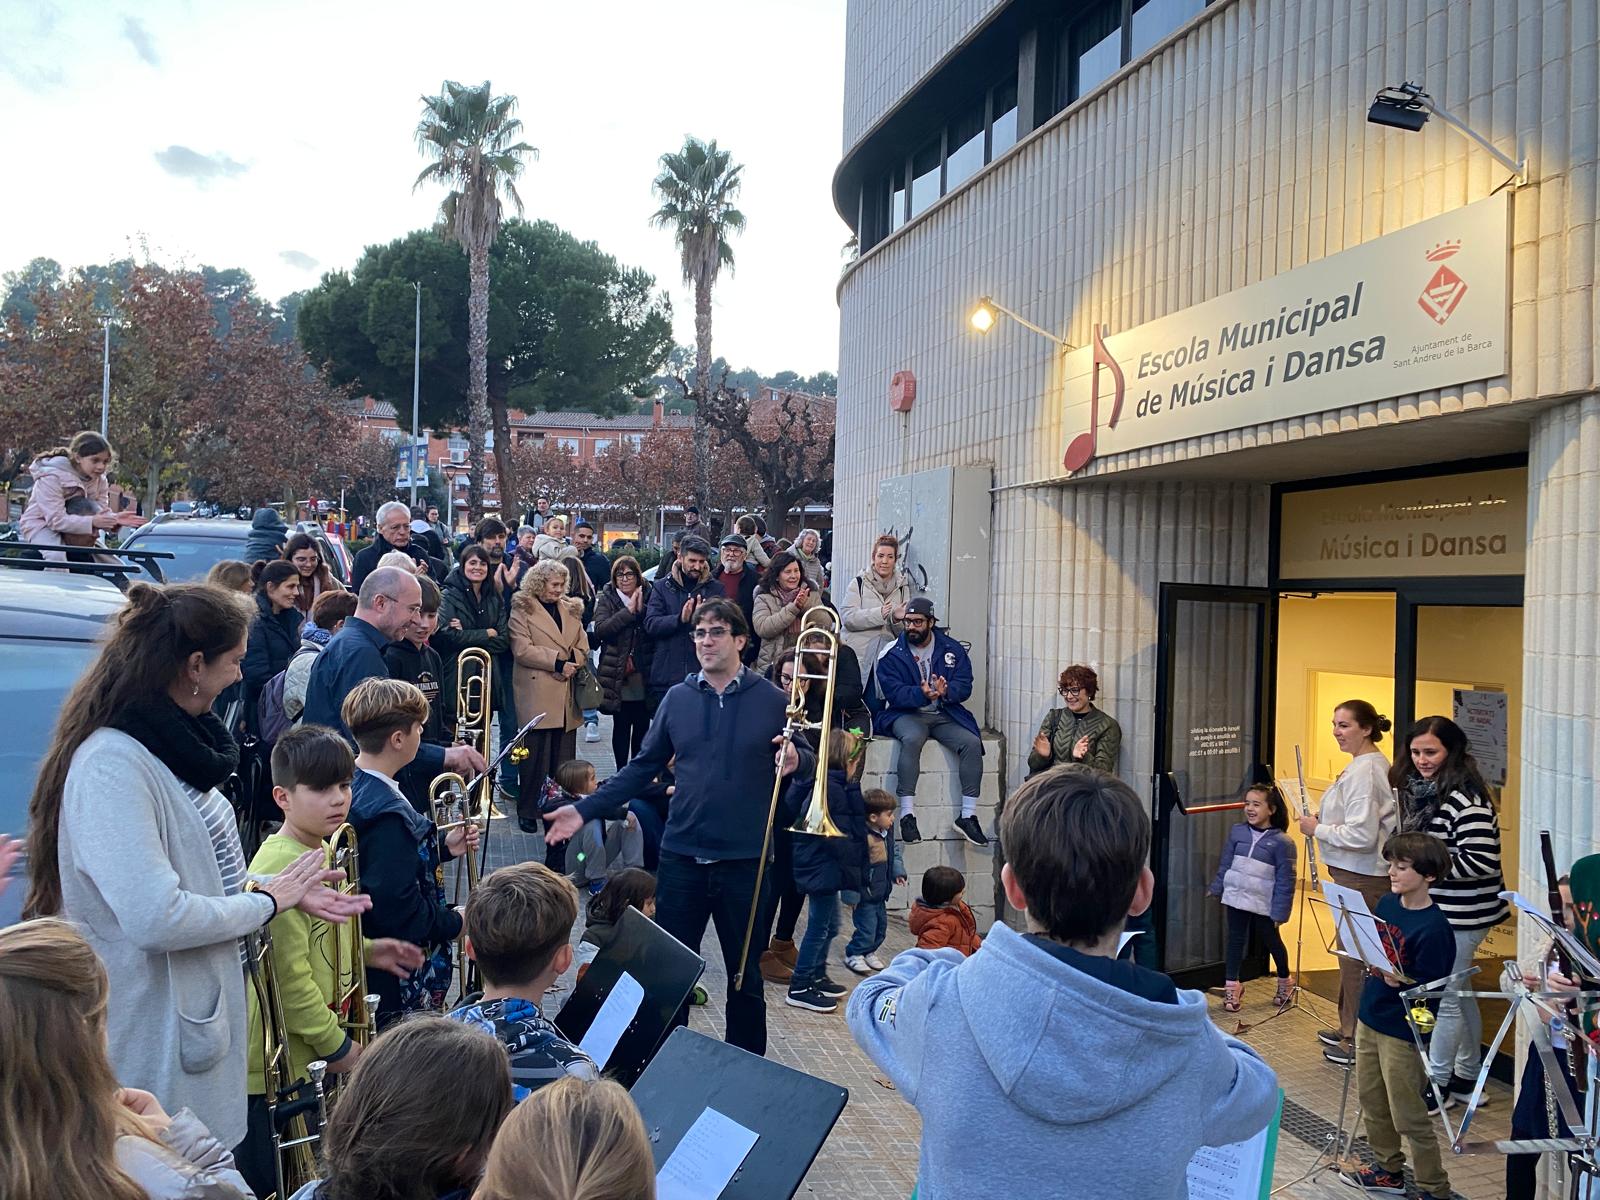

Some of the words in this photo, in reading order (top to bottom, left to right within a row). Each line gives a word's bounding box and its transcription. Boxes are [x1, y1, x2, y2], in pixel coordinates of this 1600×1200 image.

[1137, 336, 1209, 379] Escola
[1218, 281, 1364, 355] Municipal
[1412, 336, 1459, 355] Ajuntament
[1461, 333, 1472, 342] de
[1393, 359, 1411, 369] Sant
[1412, 353, 1441, 365] Andreu
[1444, 349, 1454, 358] de
[1457, 346, 1464, 354] la
[1467, 340, 1493, 352] Barca
[1136, 390, 1162, 418] de
[1169, 368, 1256, 410] Música
[1265, 355, 1276, 387] i
[1283, 335, 1386, 383] Dansa
[1320, 534, 1399, 560] Música
[1407, 533, 1413, 558] i
[1421, 532, 1507, 557] Dansa
